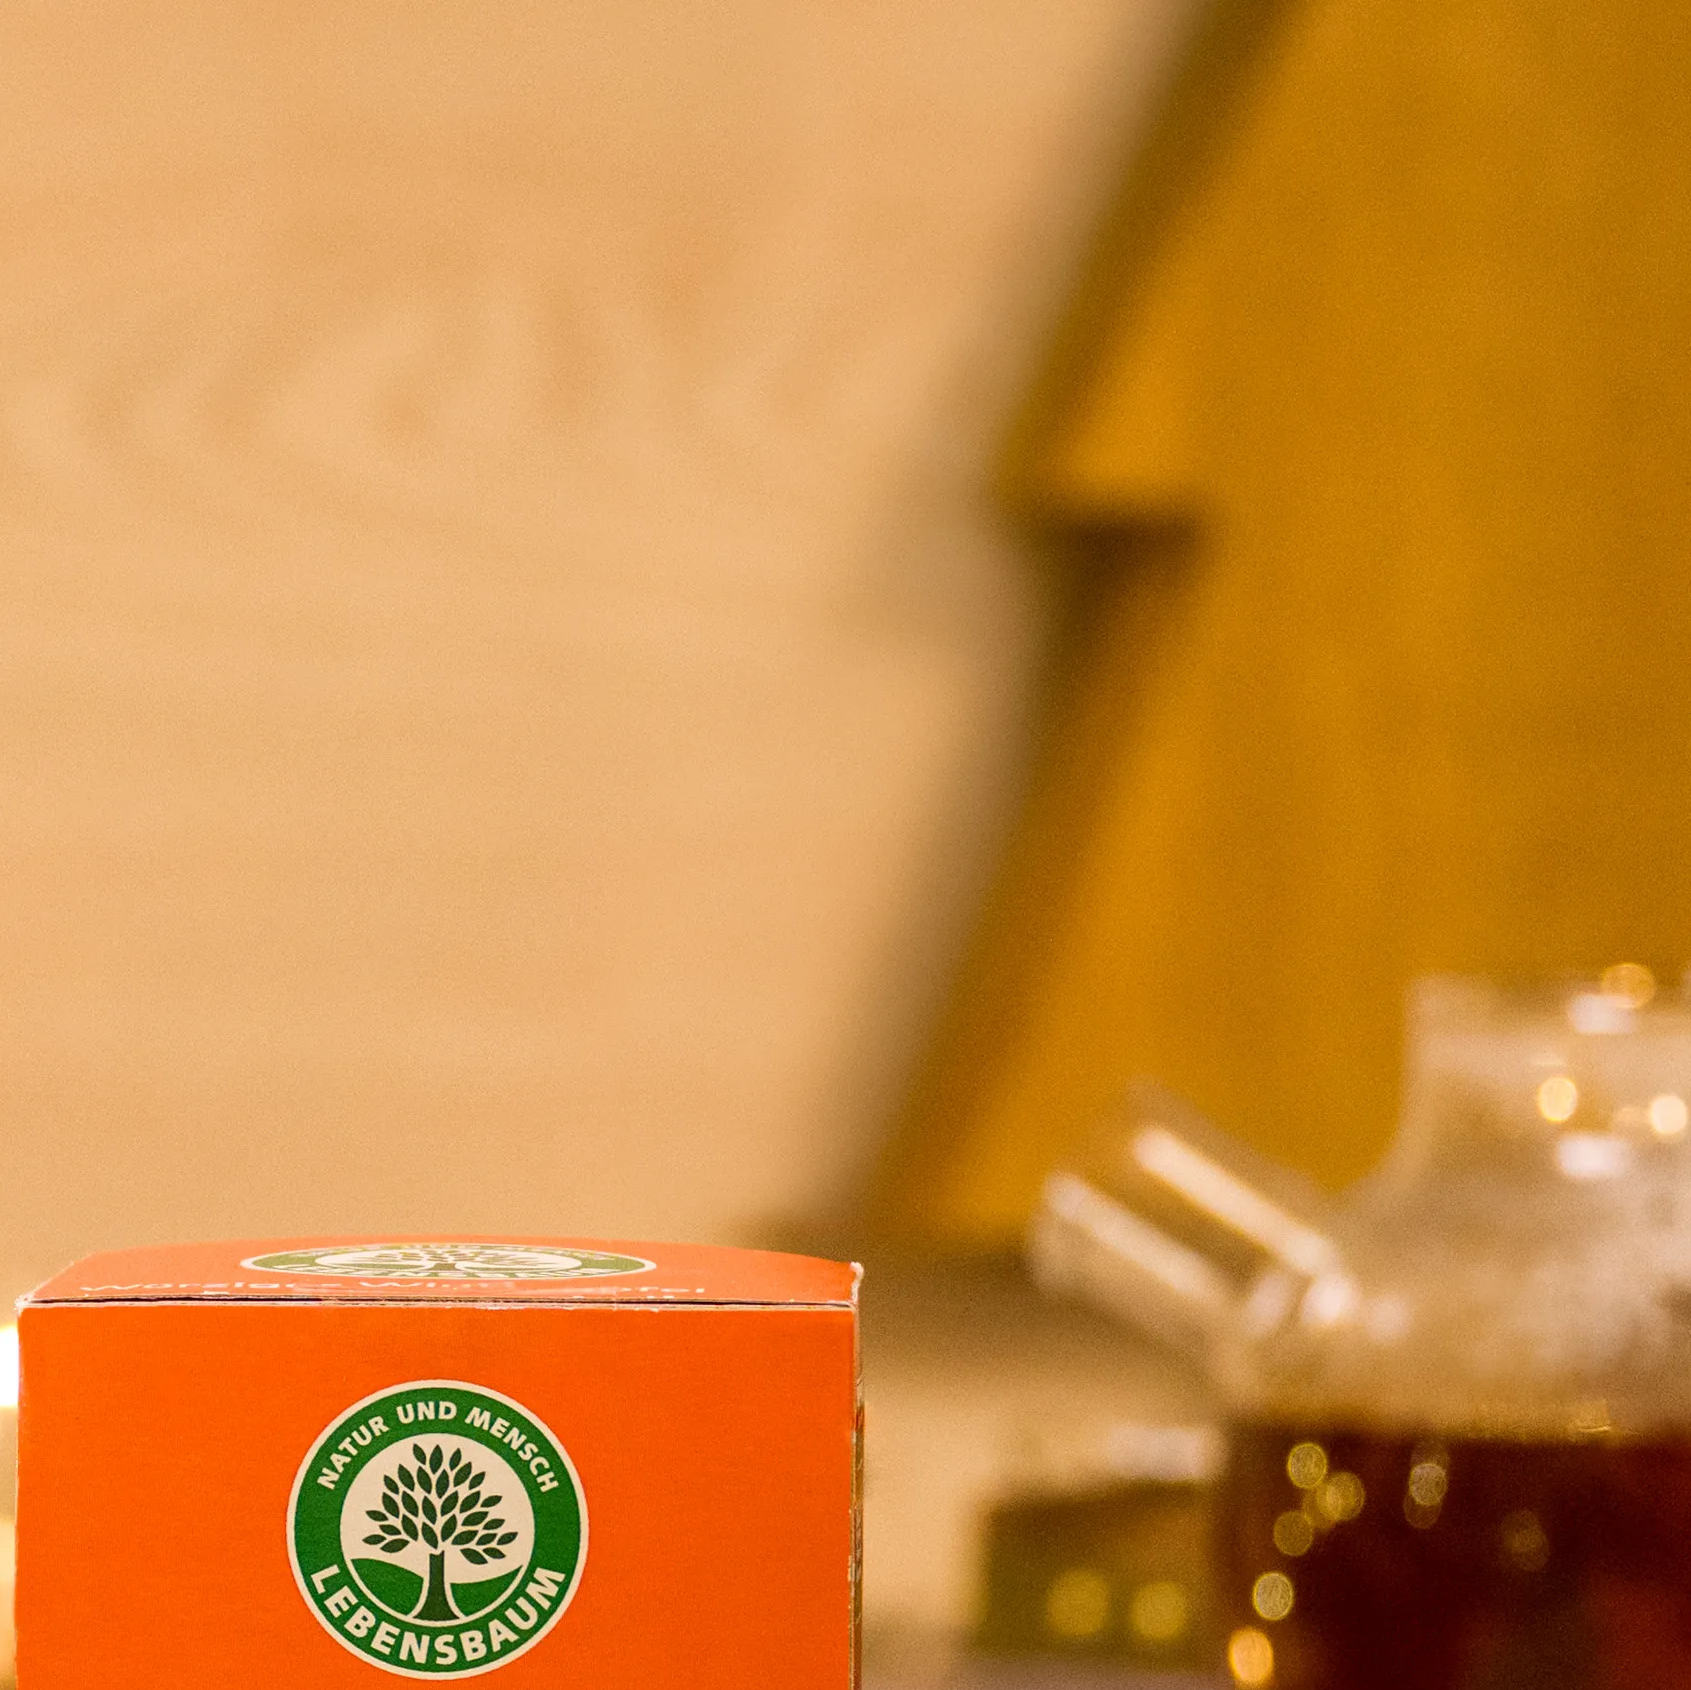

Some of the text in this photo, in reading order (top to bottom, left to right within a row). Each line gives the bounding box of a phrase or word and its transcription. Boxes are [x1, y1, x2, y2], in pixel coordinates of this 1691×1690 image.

[317, 1400, 559, 1492] NATUR UND MENSCH
[310, 1564, 566, 1665] LEBENSBAUM
